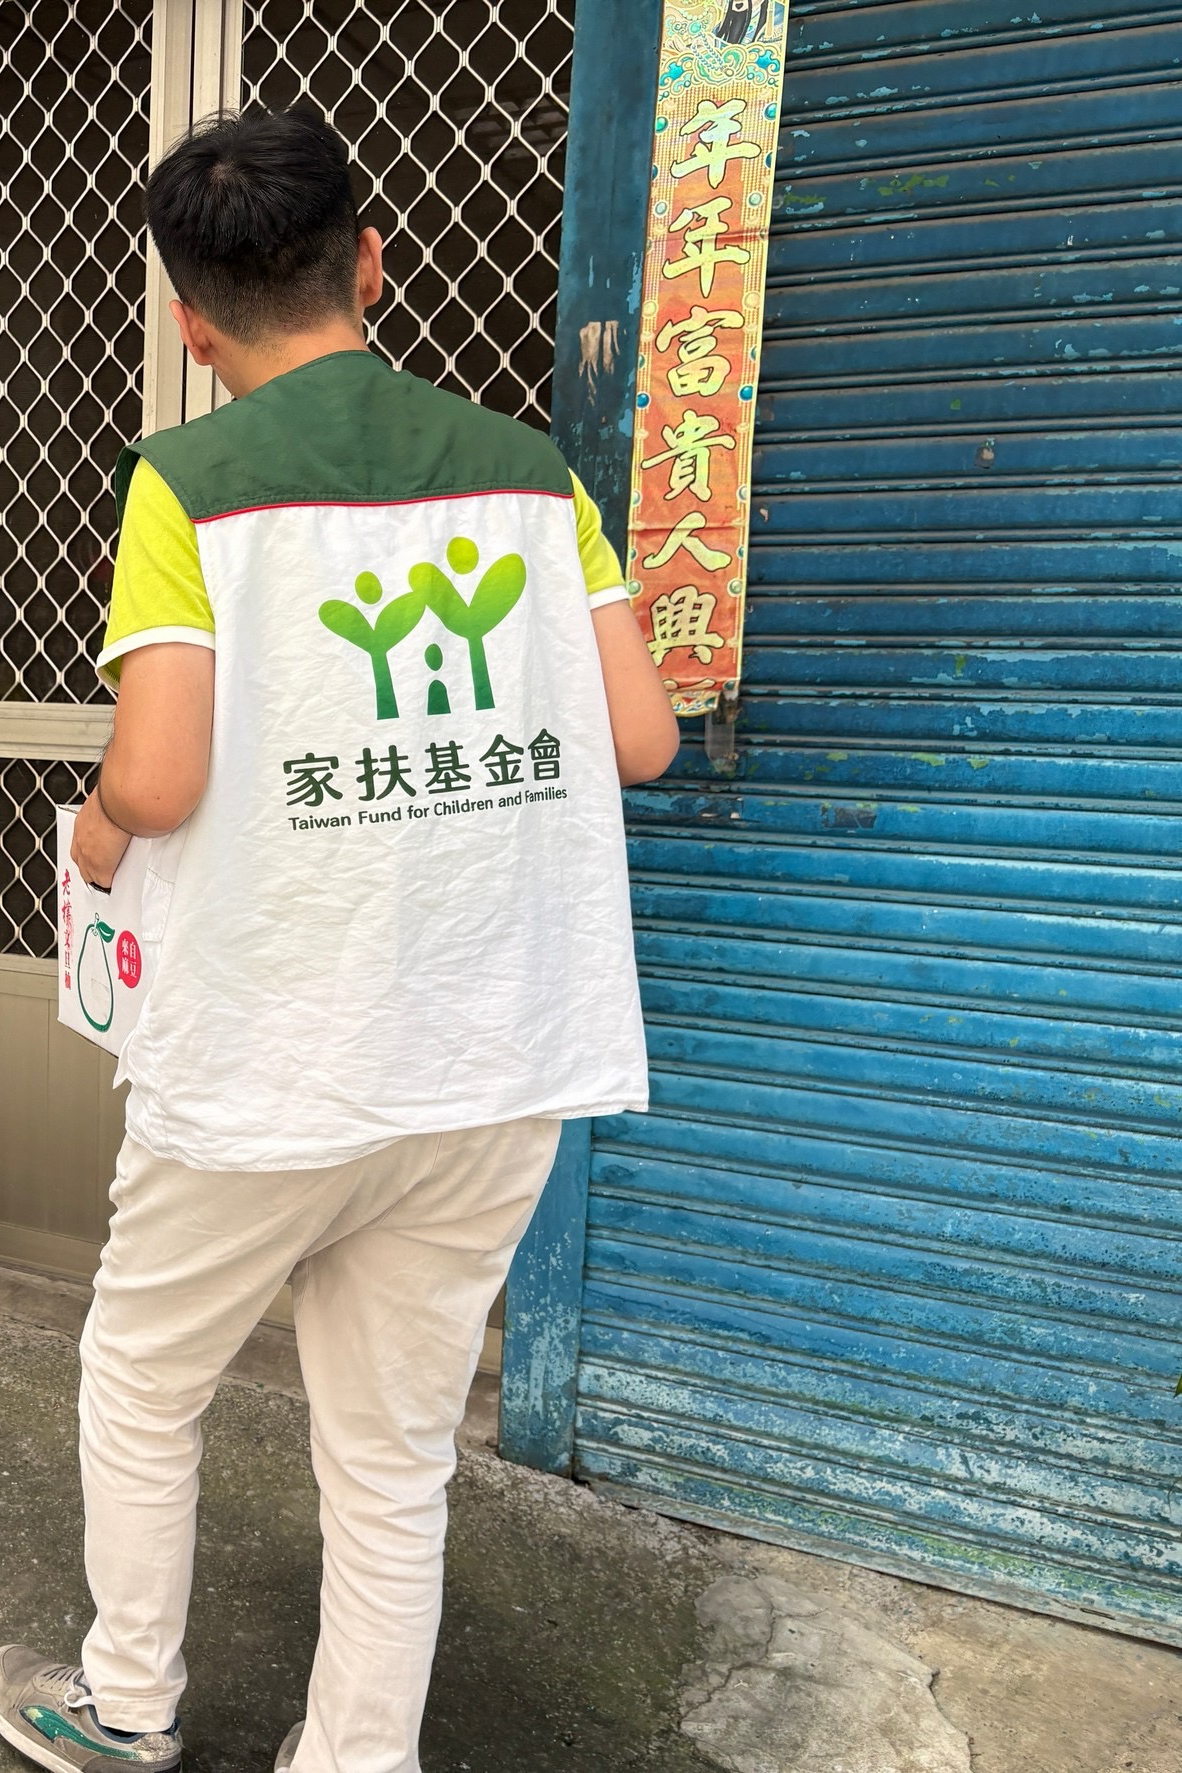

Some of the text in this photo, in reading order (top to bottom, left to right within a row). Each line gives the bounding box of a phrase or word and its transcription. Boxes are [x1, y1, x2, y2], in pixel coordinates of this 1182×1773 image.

[641, 98, 761, 692] 年年富貴人興
[282, 728, 562, 808] 家扶基金會
[288, 786, 568, 832] Taiwan Fund for Children and Families
